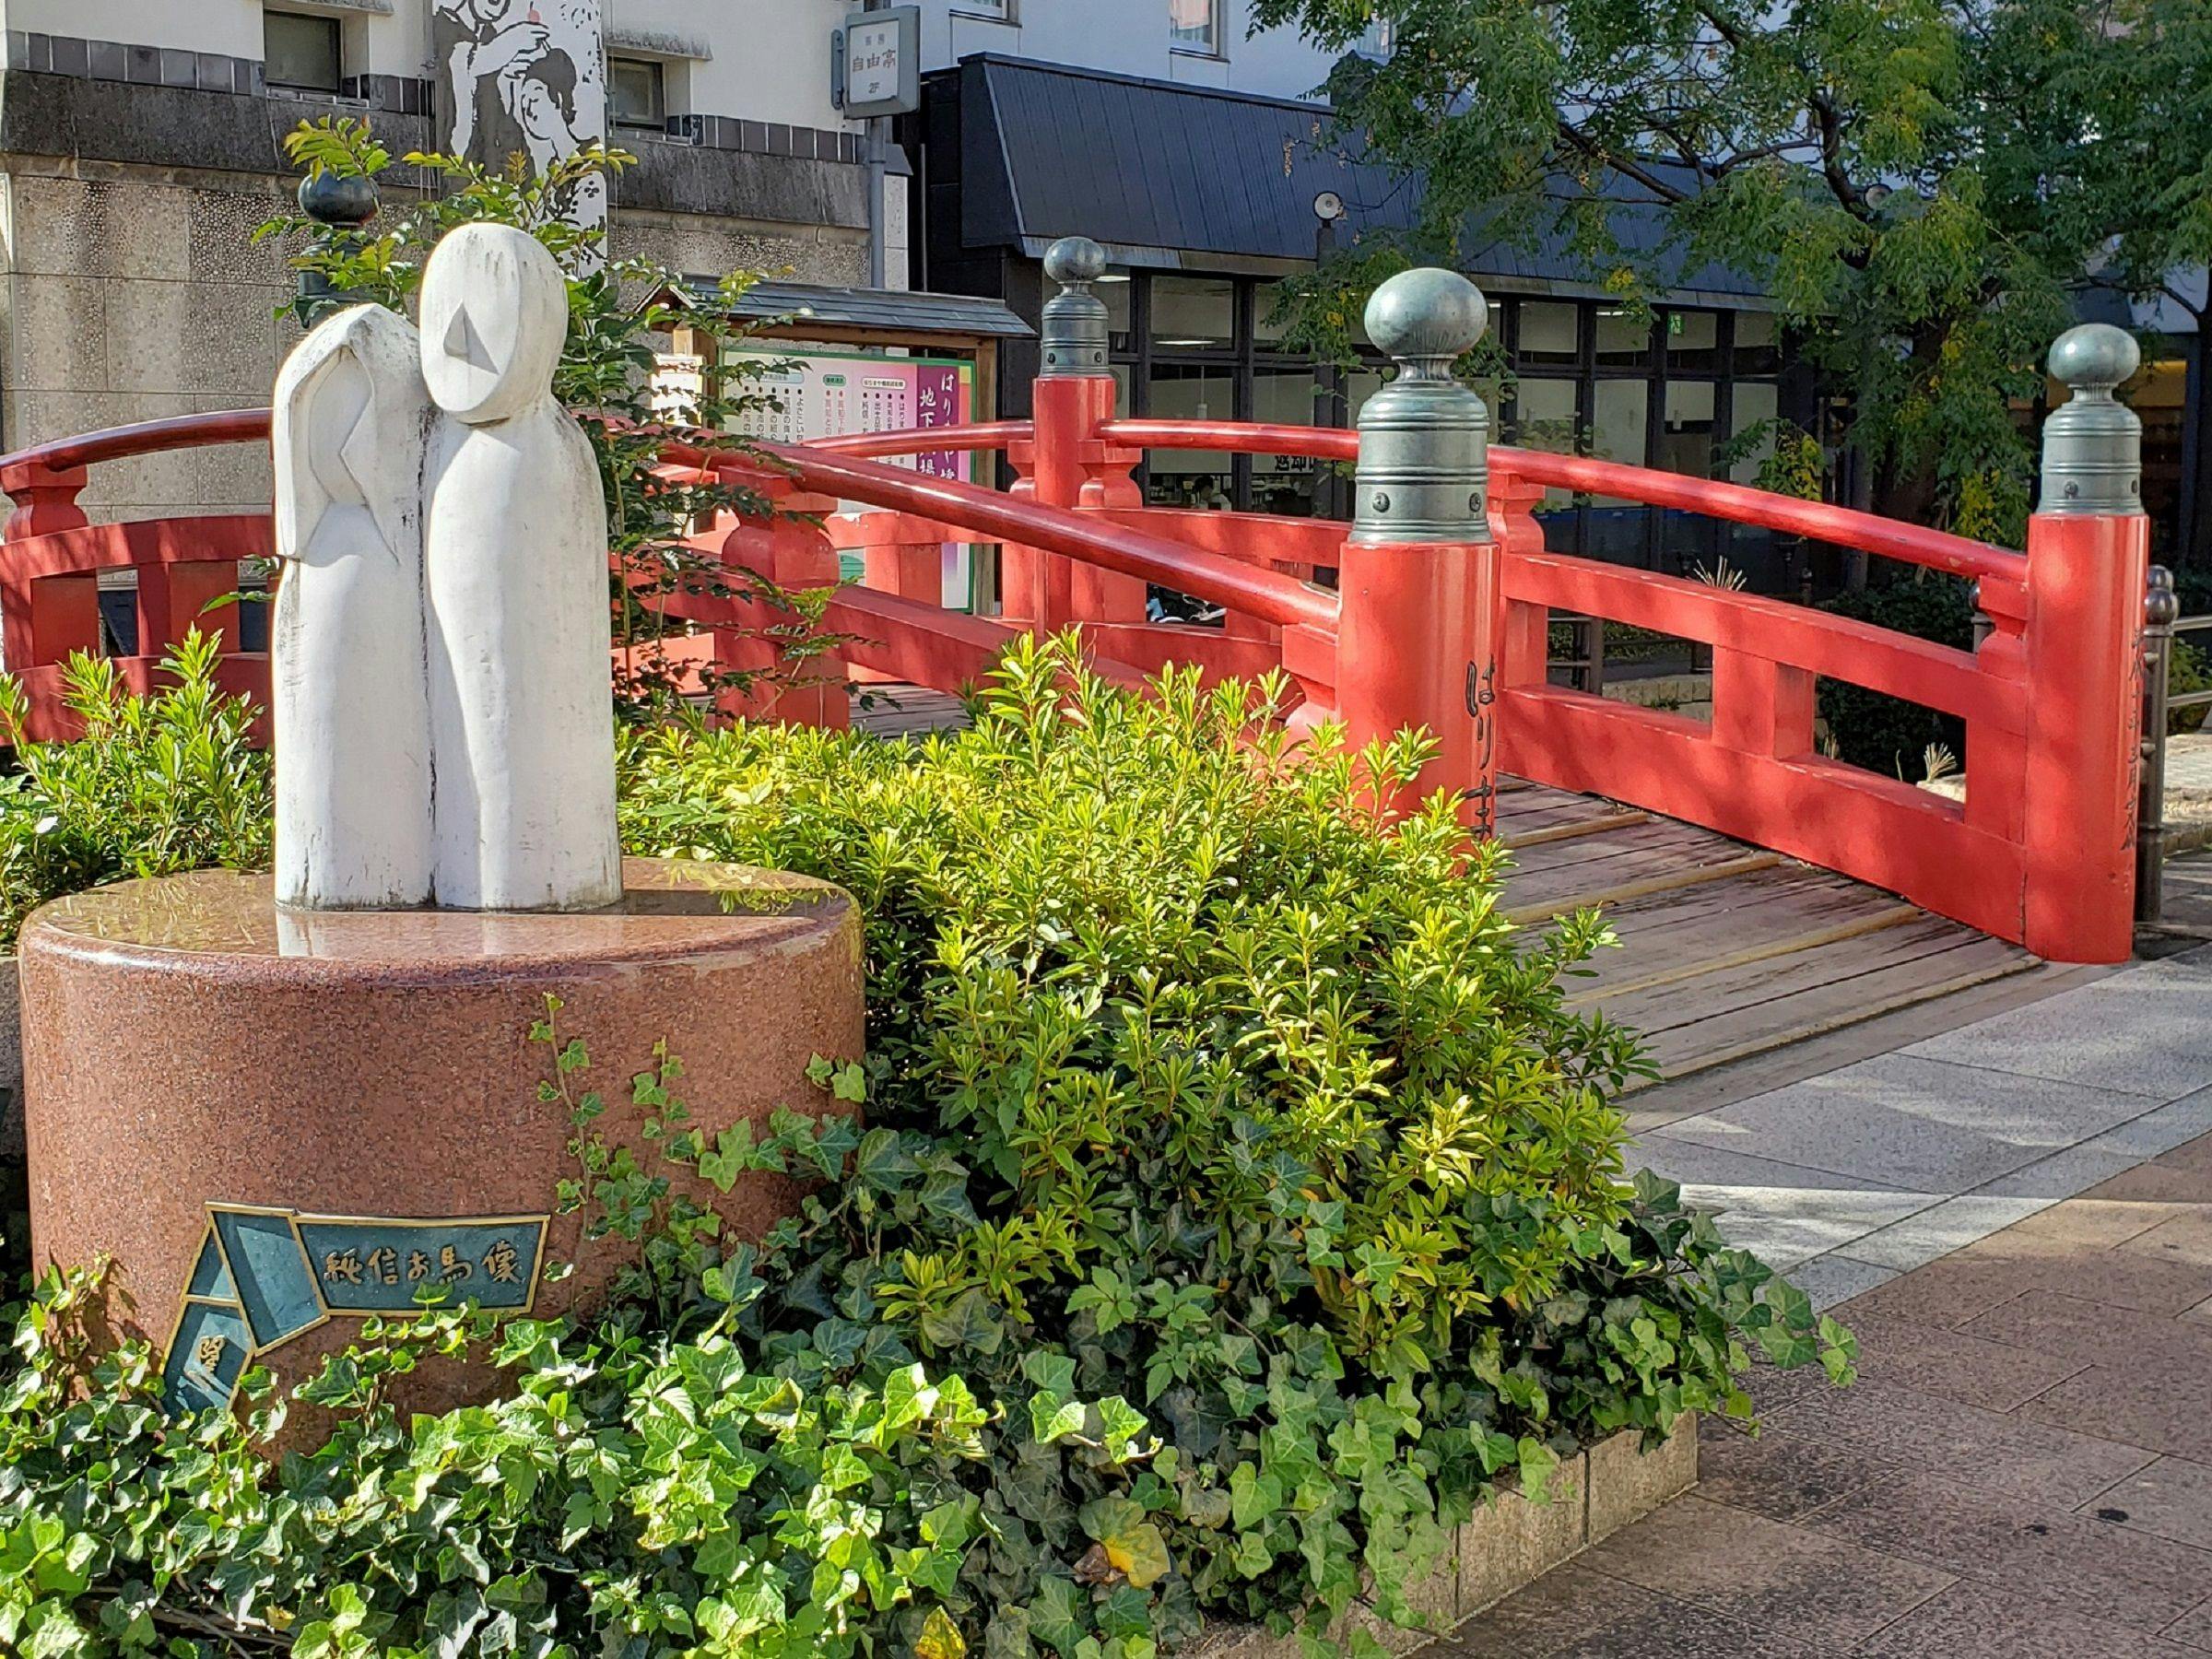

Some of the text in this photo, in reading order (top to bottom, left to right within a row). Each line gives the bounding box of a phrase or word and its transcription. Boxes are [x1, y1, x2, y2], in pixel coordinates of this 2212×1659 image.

[868, 82, 880, 94] 2F
[920, 385, 936, 477] 地下場
